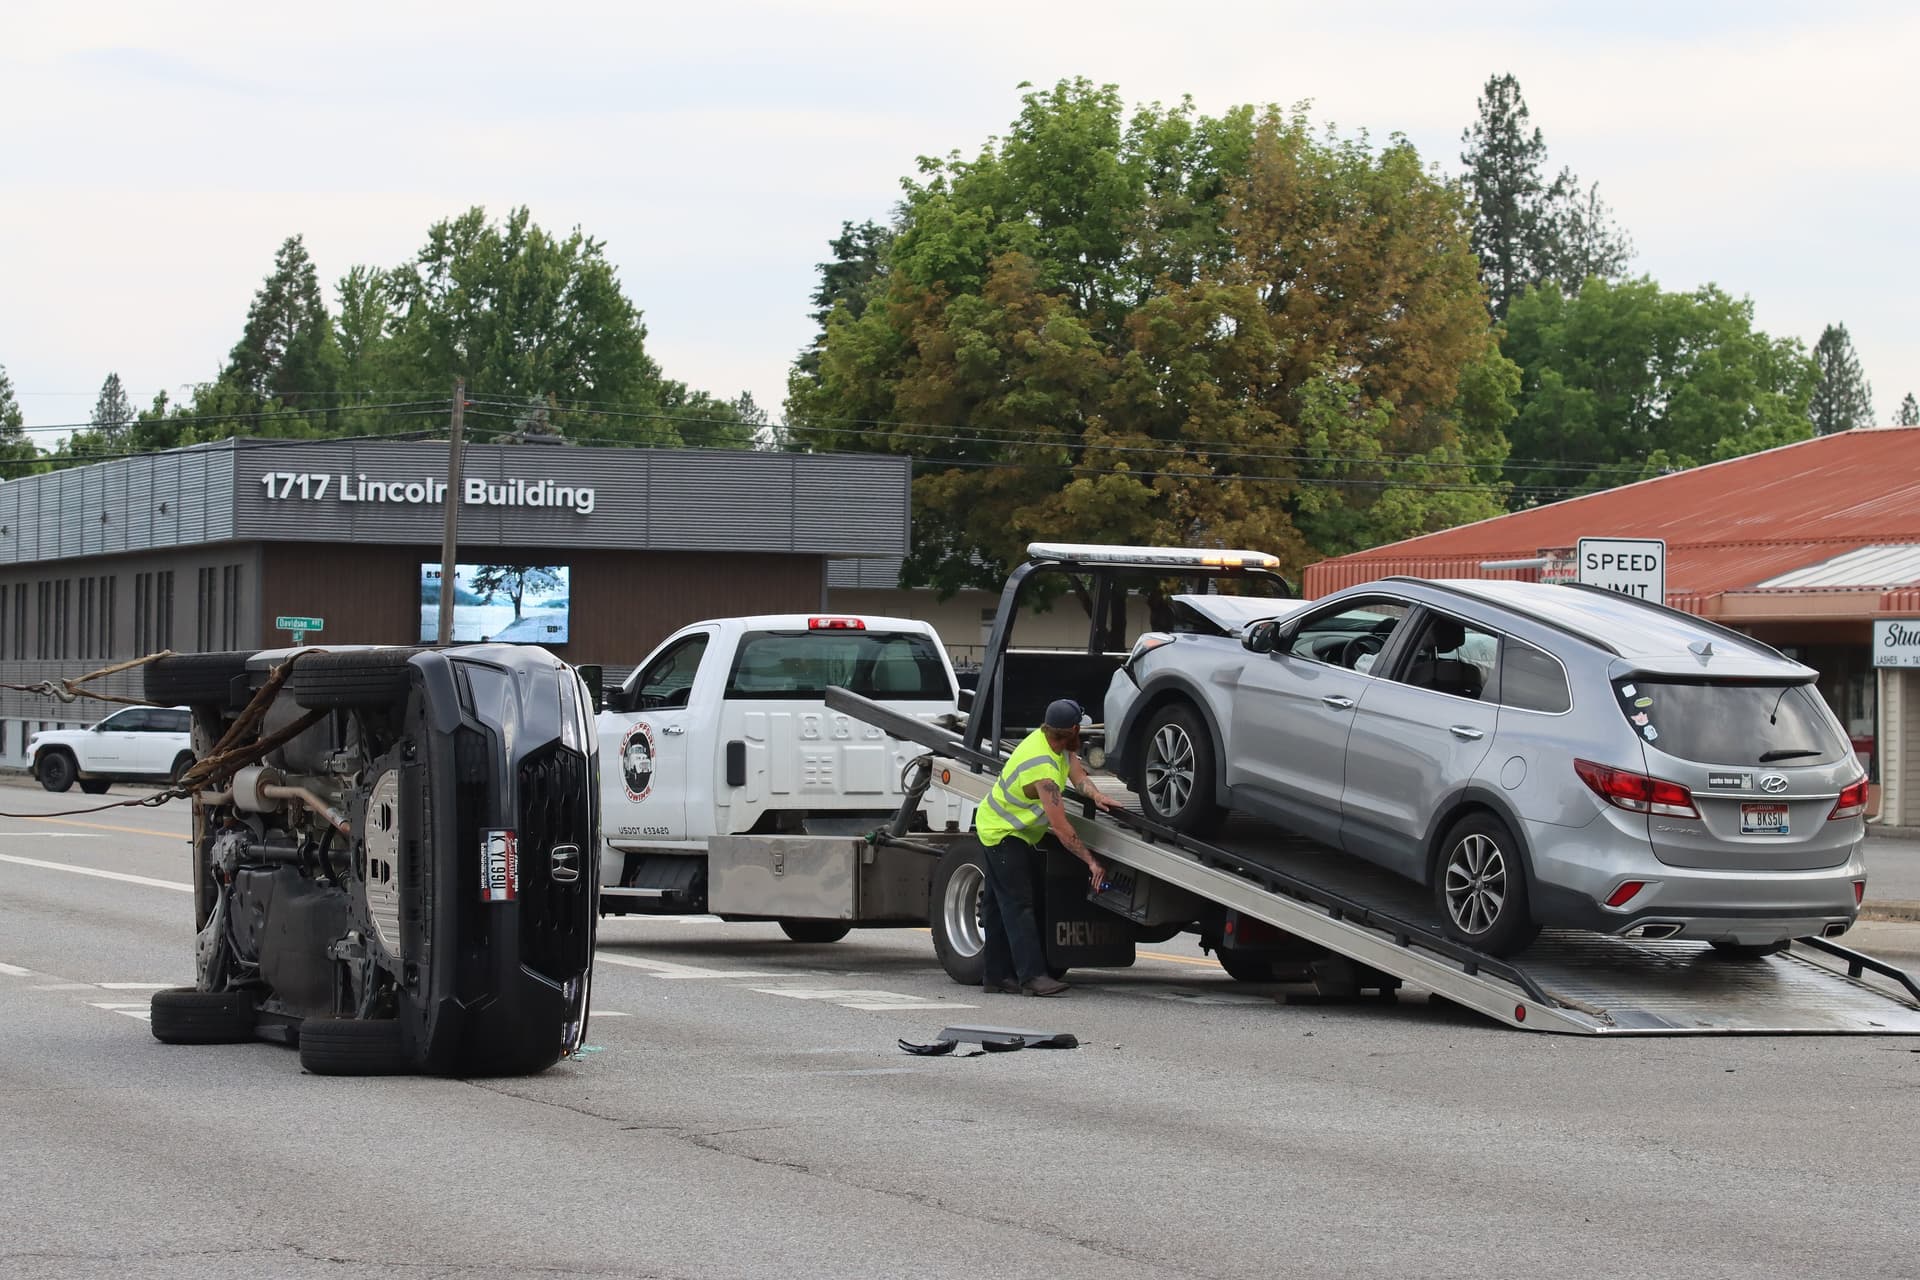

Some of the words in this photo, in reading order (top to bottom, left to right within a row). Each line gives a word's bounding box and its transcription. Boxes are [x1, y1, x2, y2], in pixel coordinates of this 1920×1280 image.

[261, 472, 330, 501] 1717
[340, 474, 448, 504] Lincoln
[464, 478, 596, 514] Building
[1586, 553, 1657, 572] SPEED
[1875, 656, 1898, 665] LASHES
[624, 785, 651, 801] TOWING
[1744, 812, 1750, 826] K
[617, 826, 641, 835] USDOT
[643, 826, 670, 835] 433420
[490, 851, 506, 889] YL99U
